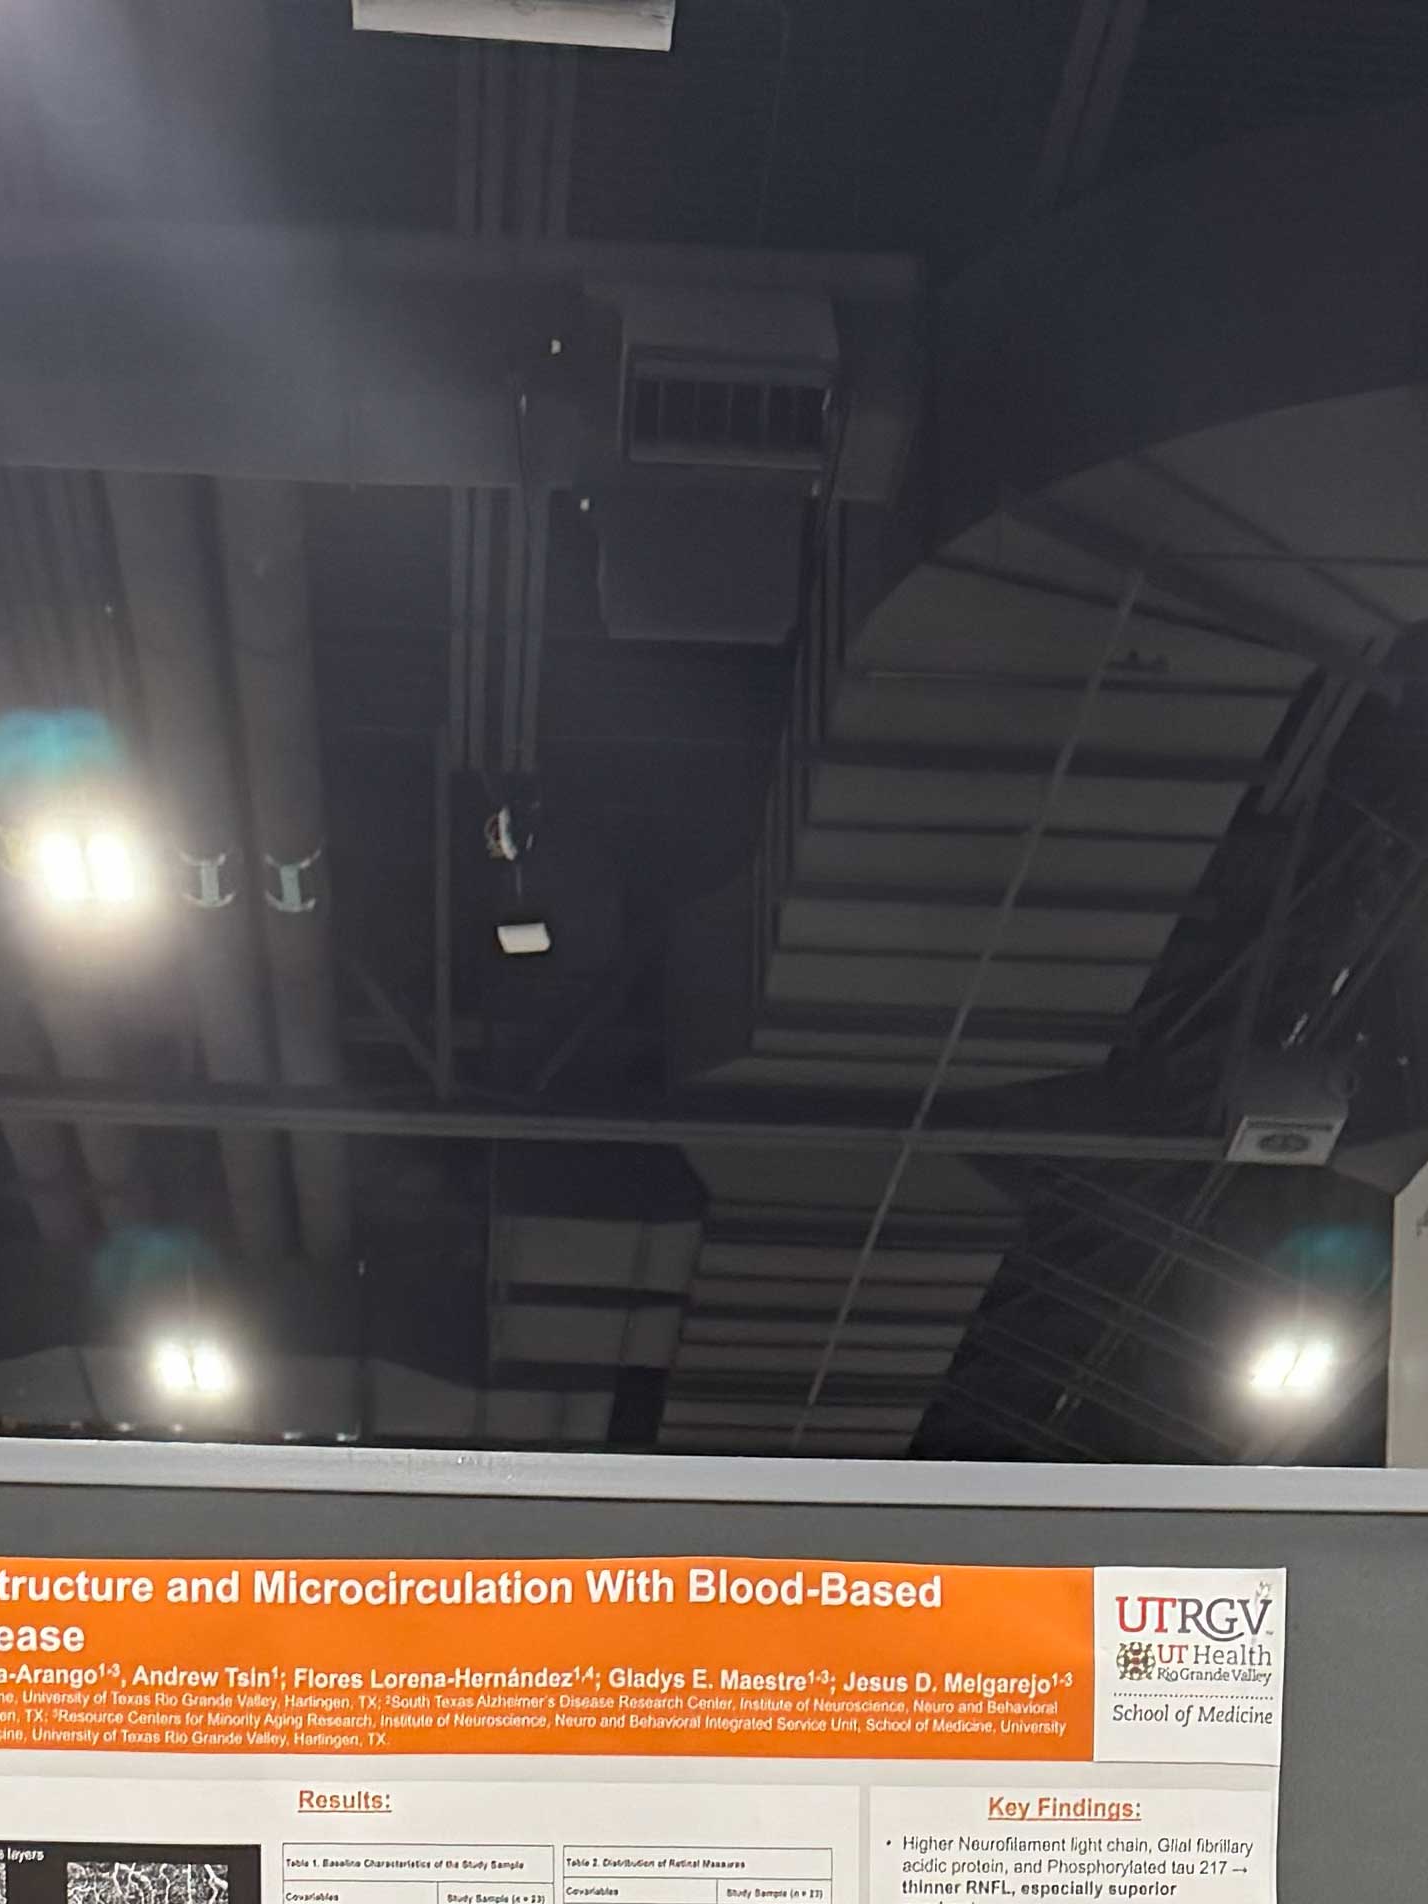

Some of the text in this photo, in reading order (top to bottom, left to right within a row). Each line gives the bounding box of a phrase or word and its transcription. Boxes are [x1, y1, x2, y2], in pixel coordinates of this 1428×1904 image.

[168, 1571, 240, 1602] and
[255, 1569, 571, 1605] Microcirculation
[587, 1570, 674, 1606] With
[688, 1571, 943, 1609] Blood-Based
[1116, 1597, 1272, 1641] UTRGV
[1158, 1645, 1272, 1666] UT Health
[1158, 1667, 1272, 1686] Rio Grande Valley
[1113, 1704, 1273, 1727] School of Medicine
[298, 1790, 392, 1813] Results:
[988, 1798, 1142, 1822] Key Findings:
[903, 1836, 1253, 1858] Higher Neurofilament light chain, Glial fibrillary
[903, 1858, 1227, 1877] acidic protein, and Phosphorylated tau 217
[903, 1880, 1177, 1898] thinner RNFL, especially superior
